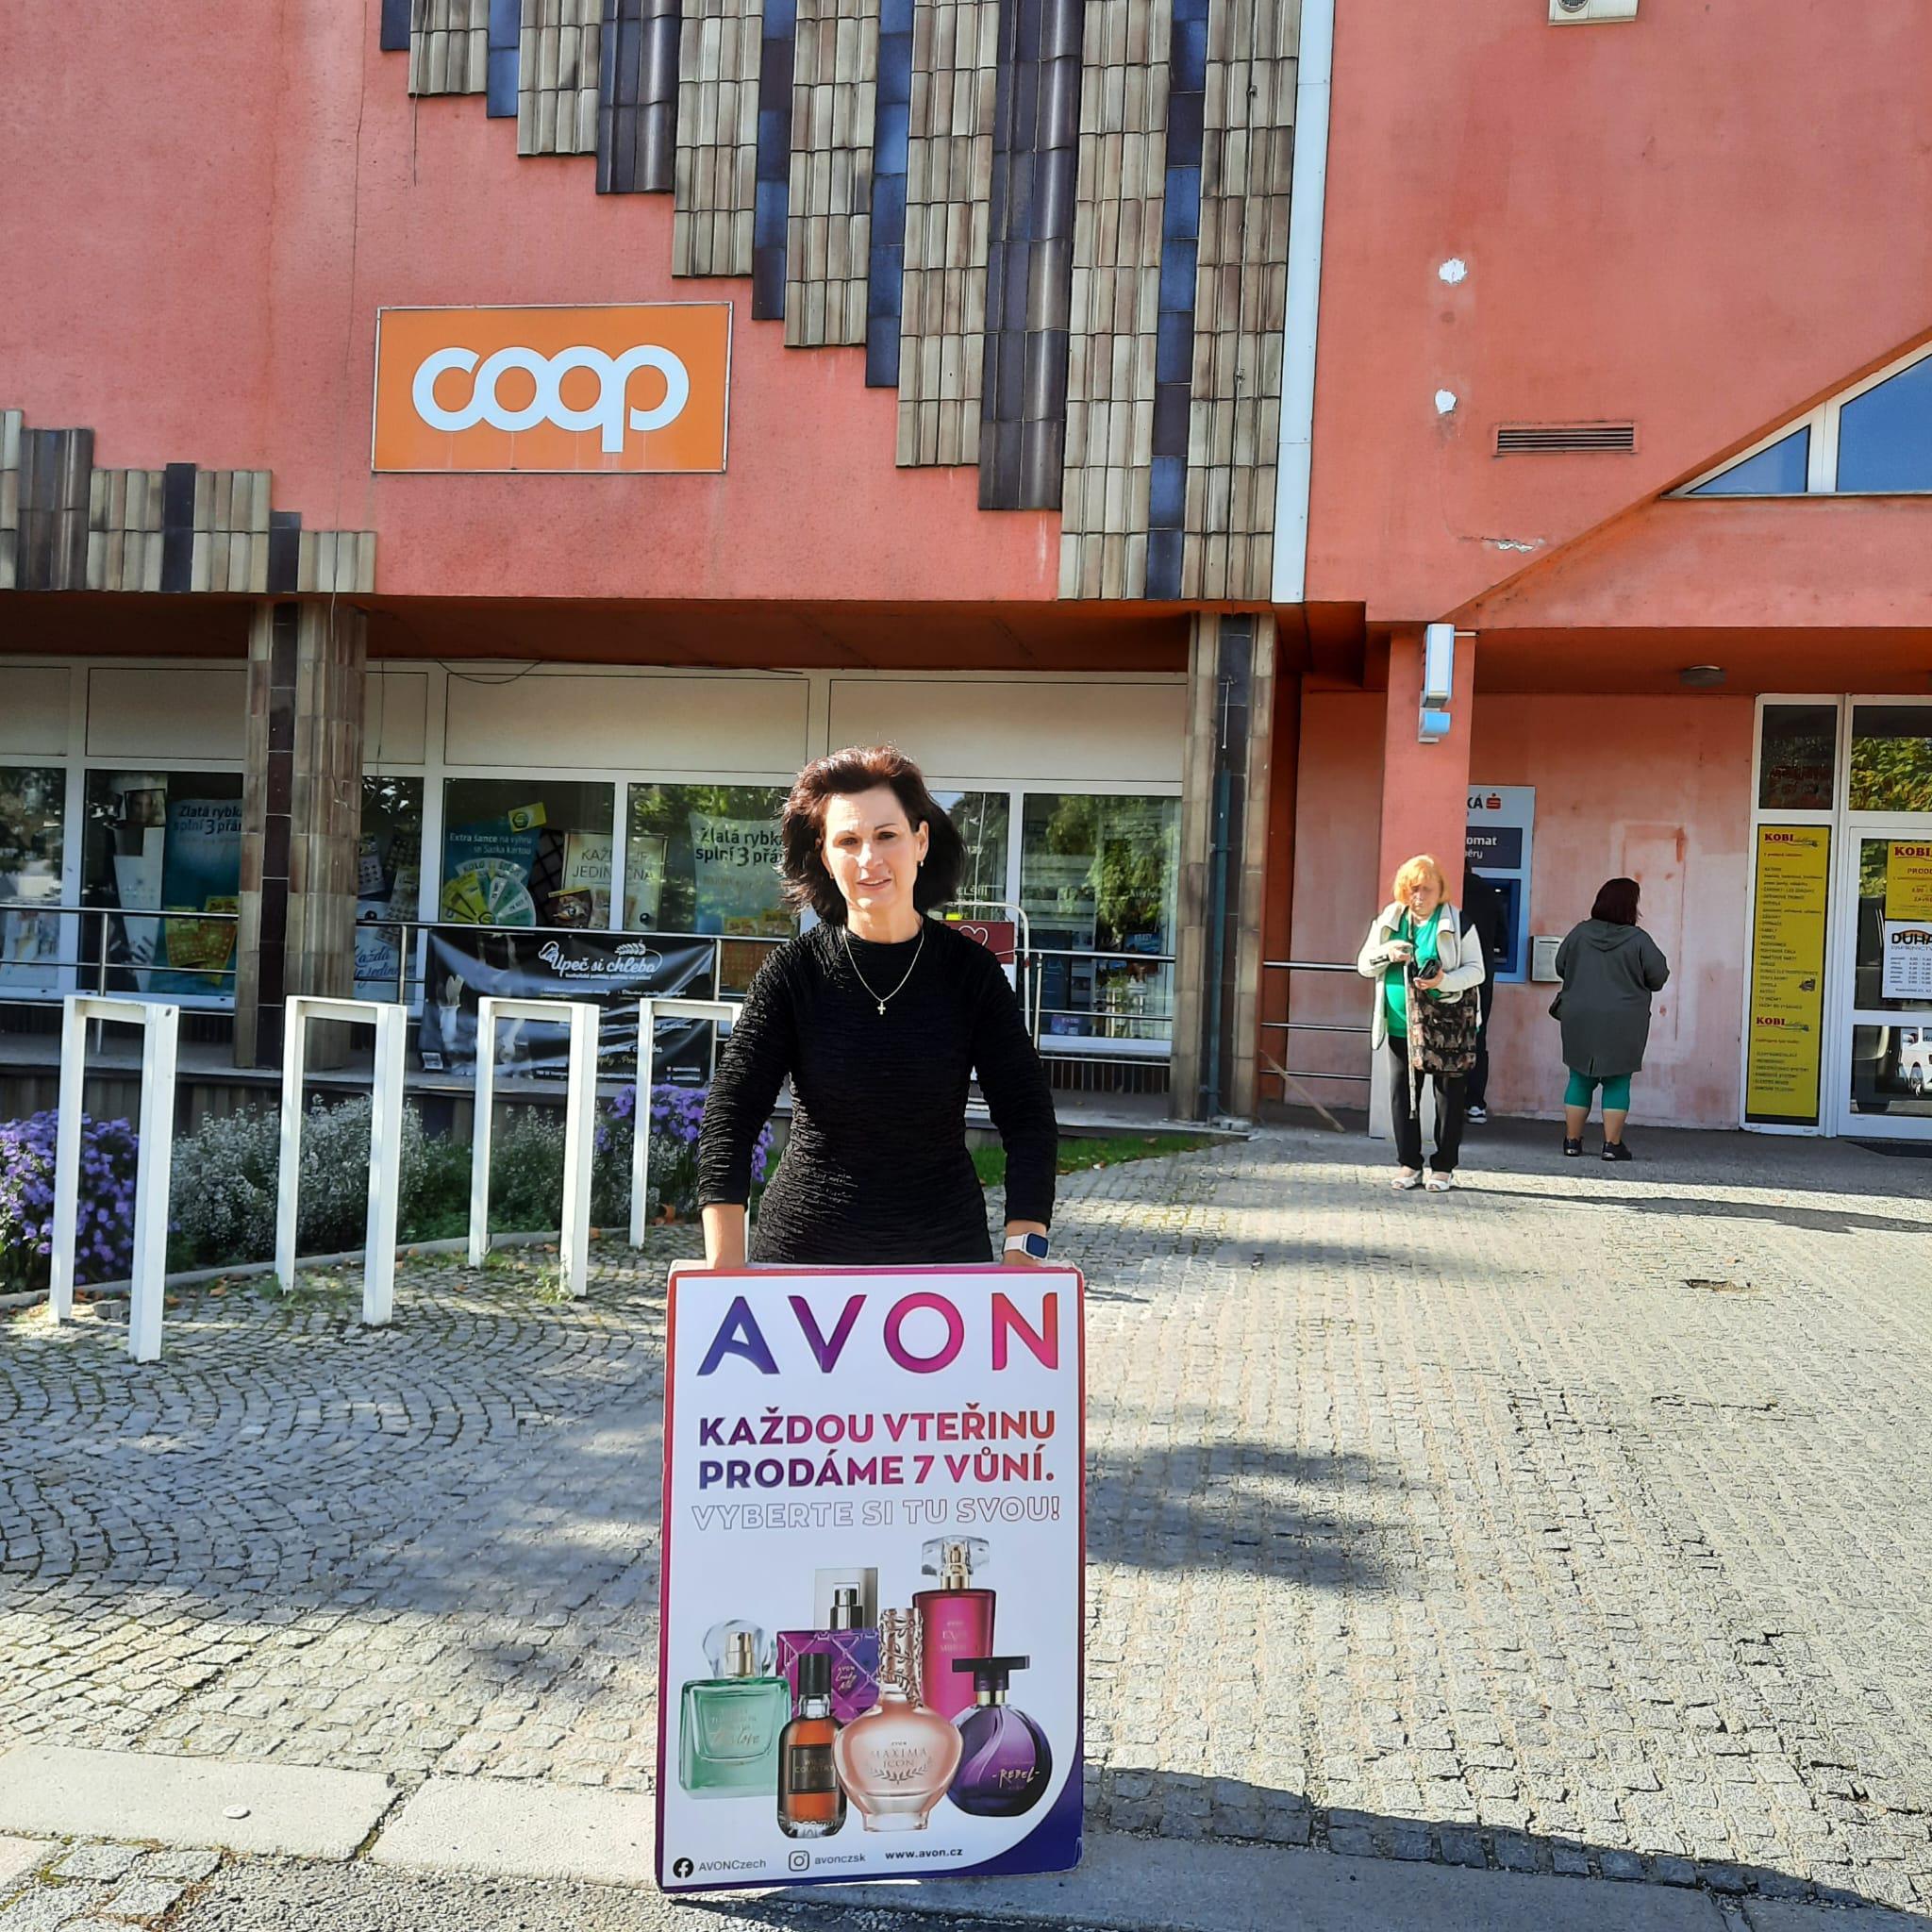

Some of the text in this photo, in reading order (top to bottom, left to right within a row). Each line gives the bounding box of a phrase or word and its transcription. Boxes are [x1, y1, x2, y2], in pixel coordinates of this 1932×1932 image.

[412, 344, 690, 453] coop
[178, 806, 209, 818] Zlatá
[174, 819, 204, 832] splní
[205, 819, 215, 835] 3
[450, 833, 472, 842] Extra
[701, 827, 782, 848] Zlatá rybk
[1466, 836, 1497, 845] omat
[1764, 833, 1793, 841] KOBI
[695, 845, 733, 863] splní
[737, 846, 749, 867] 3
[1894, 846, 1931, 857] KOBI
[551, 954, 590, 977] Upeč
[591, 958, 604, 972] si
[607, 958, 658, 974] chleba
[1757, 1016, 1785, 1025] KOBI
[696, 1291, 1058, 1375] AVON
[699, 1403, 1055, 1446] KAŽDOU VTEŘINU
[699, 1444, 1055, 1490] PRODÁME 7 VŮNÍ.
[691, 1496, 1060, 1531] VYBERTE SI TU SVOU!
[814, 1852, 866, 1865] avonczsk
[885, 1846, 963, 1860] www.avon.cz
[699, 1858, 766, 1872] AVONCzech
